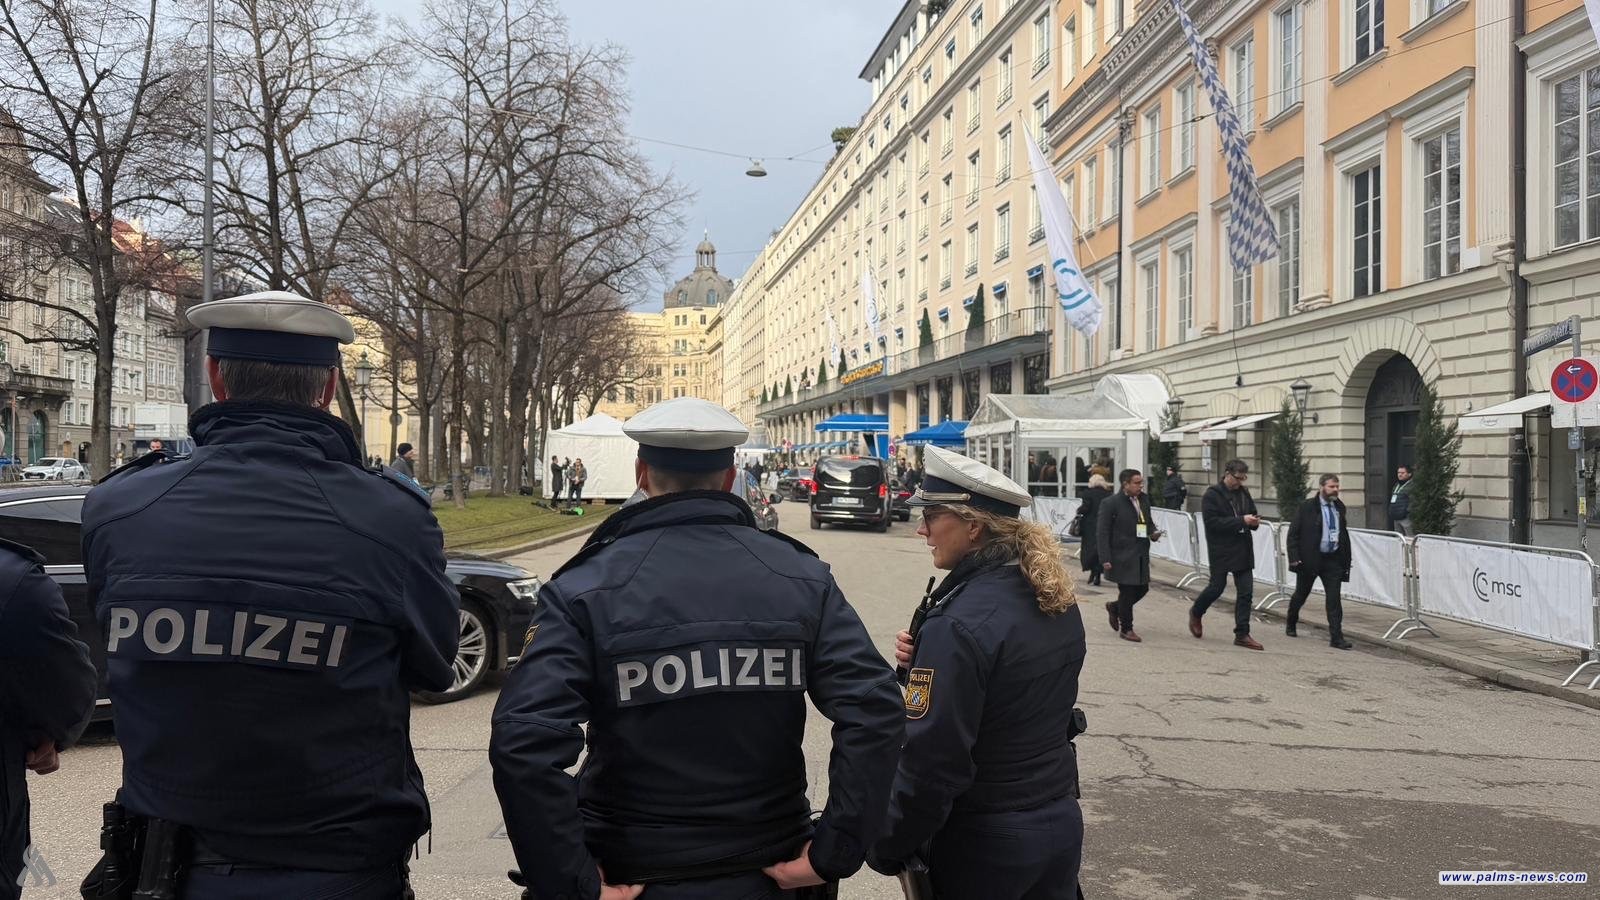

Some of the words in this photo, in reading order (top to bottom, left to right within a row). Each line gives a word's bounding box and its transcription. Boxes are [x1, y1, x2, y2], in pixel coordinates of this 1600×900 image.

[1491, 581, 1522, 598] msc
[107, 607, 347, 667] POLIZEI
[617, 648, 802, 701] POLIZEI
